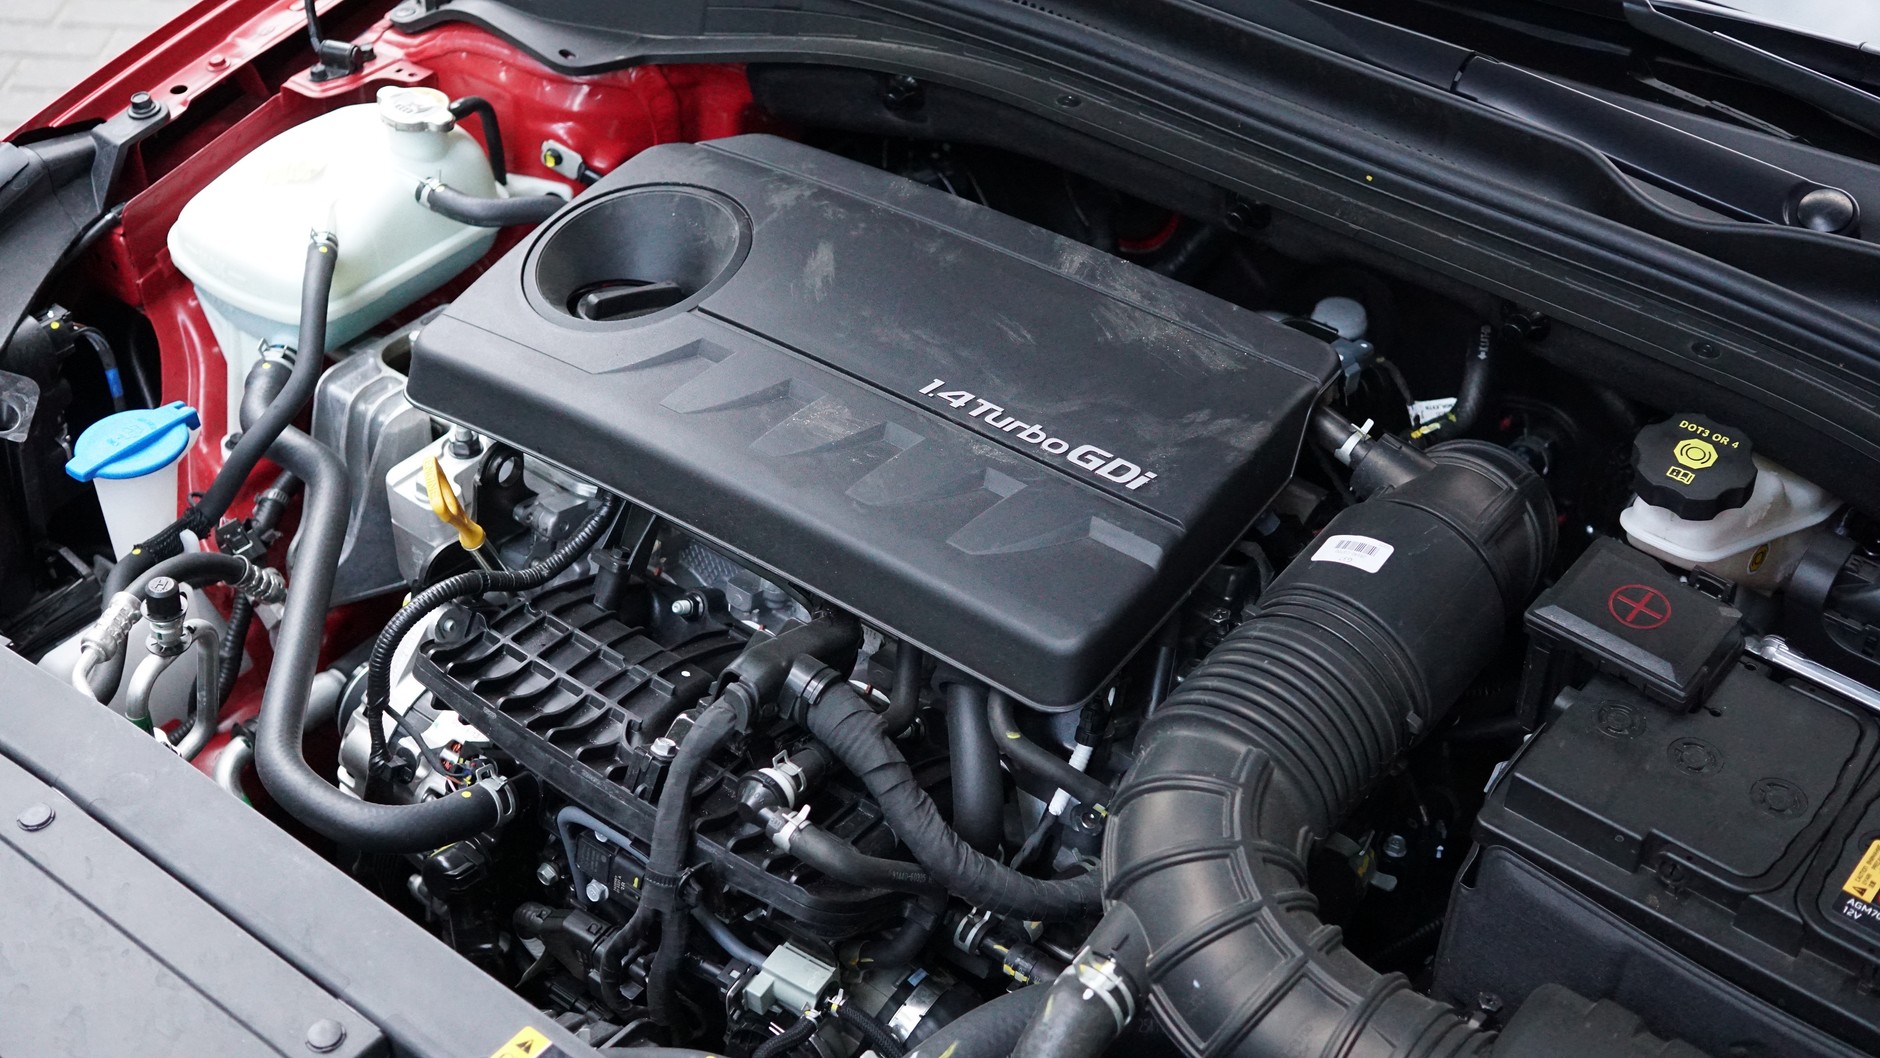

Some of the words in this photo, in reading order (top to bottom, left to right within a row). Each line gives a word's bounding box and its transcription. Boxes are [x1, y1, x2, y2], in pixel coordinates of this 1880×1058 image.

[968, 398, 1070, 455] Turbo
[1066, 444, 1159, 491] GDi
[1679, 420, 1710, 437] DOT3
[1712, 433, 1730, 445] OR
[1731, 441, 1740, 449] 4
[1843, 906, 1862, 920] 12V
